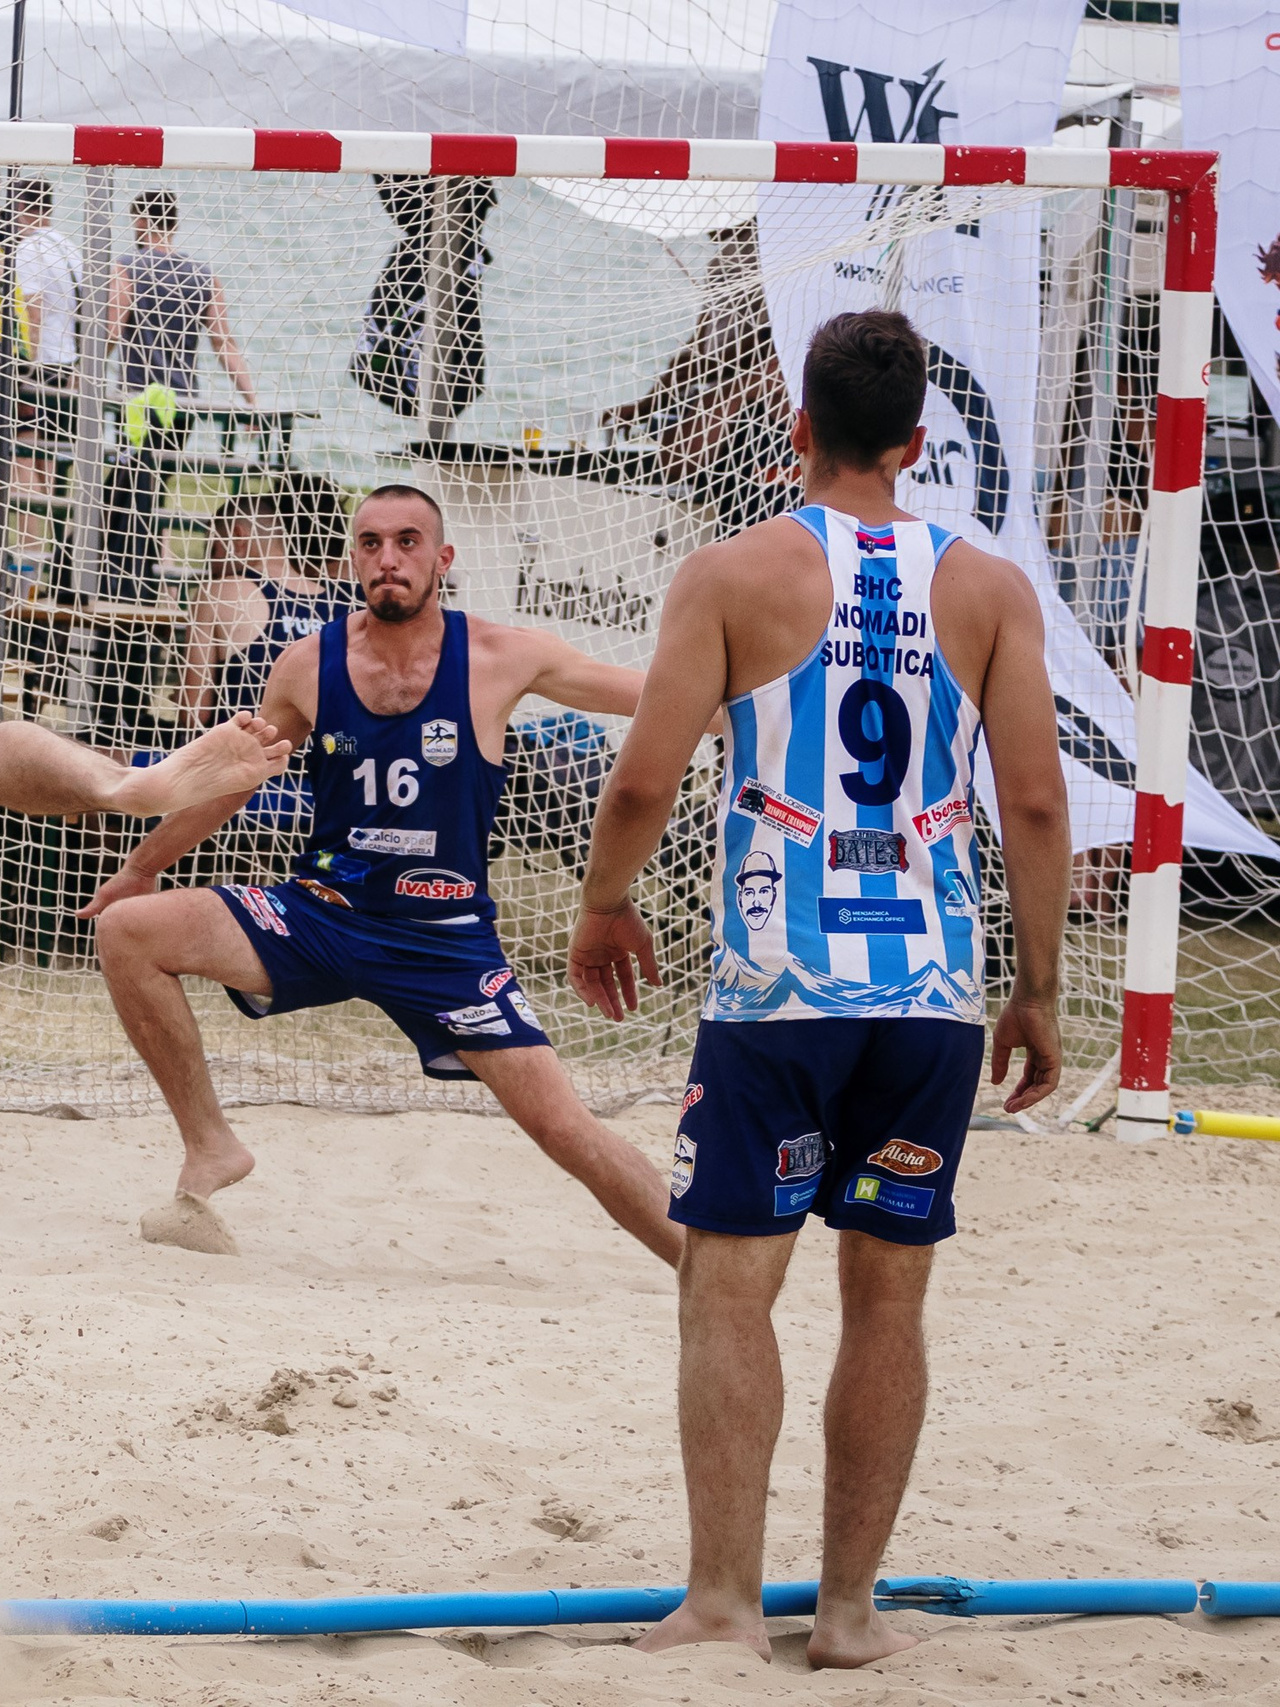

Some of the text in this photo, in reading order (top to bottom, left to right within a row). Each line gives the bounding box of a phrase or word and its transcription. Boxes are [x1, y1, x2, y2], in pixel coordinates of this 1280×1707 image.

[853, 572, 903, 602] BHC
[834, 602, 927, 639] NOMADI
[819, 640, 935, 680] SUBOTICA
[837, 678, 913, 807] 9
[352, 758, 420, 807] 16
[783, 795, 822, 821] LOGISTIKA
[404, 833, 434, 848] sped
[835, 839, 900, 865] BATES
[396, 879, 475, 899] IVAŠPED
[462, 1009, 486, 1020] Auto
[880, 1144, 926, 1166] Aloha
